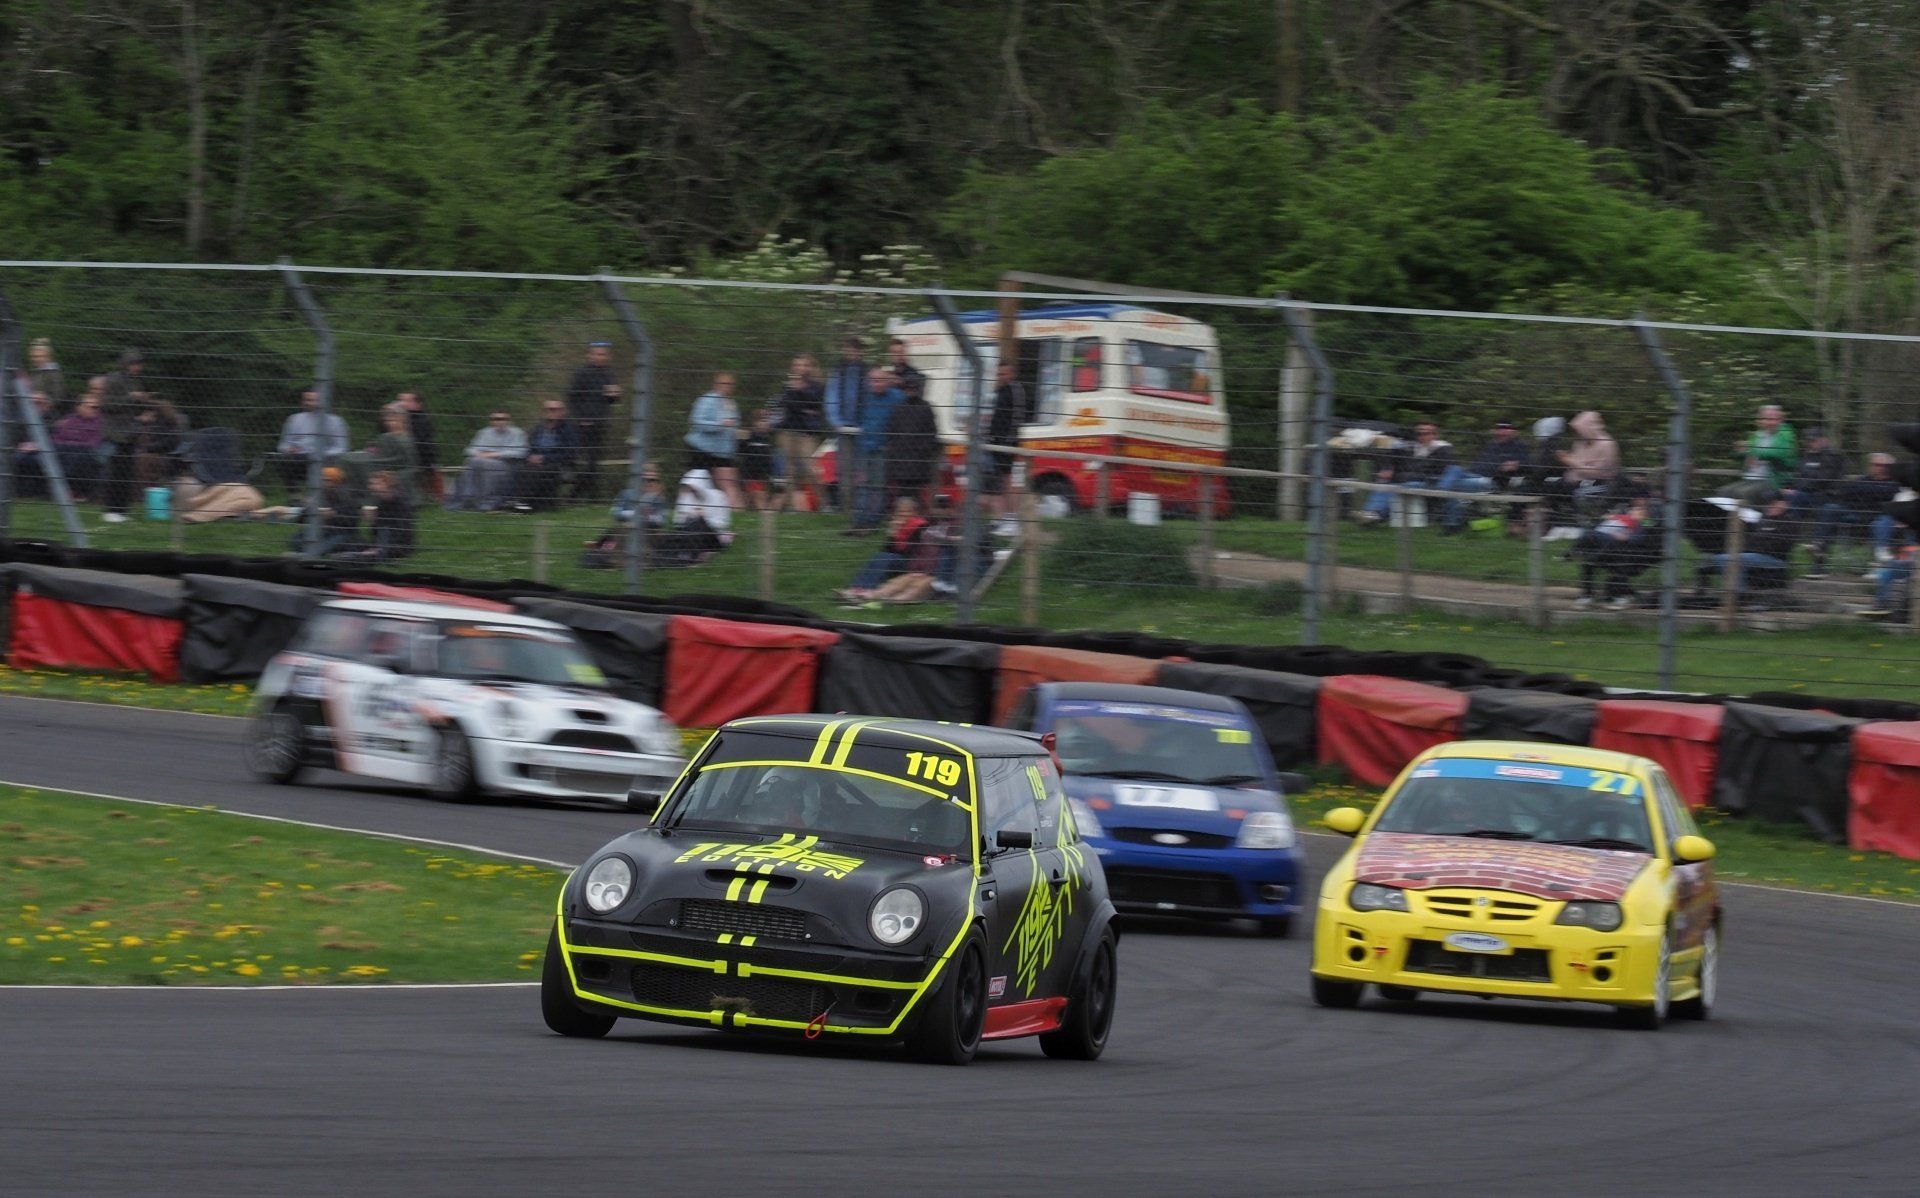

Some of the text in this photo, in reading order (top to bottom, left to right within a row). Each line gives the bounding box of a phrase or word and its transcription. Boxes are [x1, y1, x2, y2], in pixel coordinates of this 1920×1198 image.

[905, 751, 961, 787] 119
[1026, 765, 1047, 800] 119
[673, 854, 848, 880] EDITION
